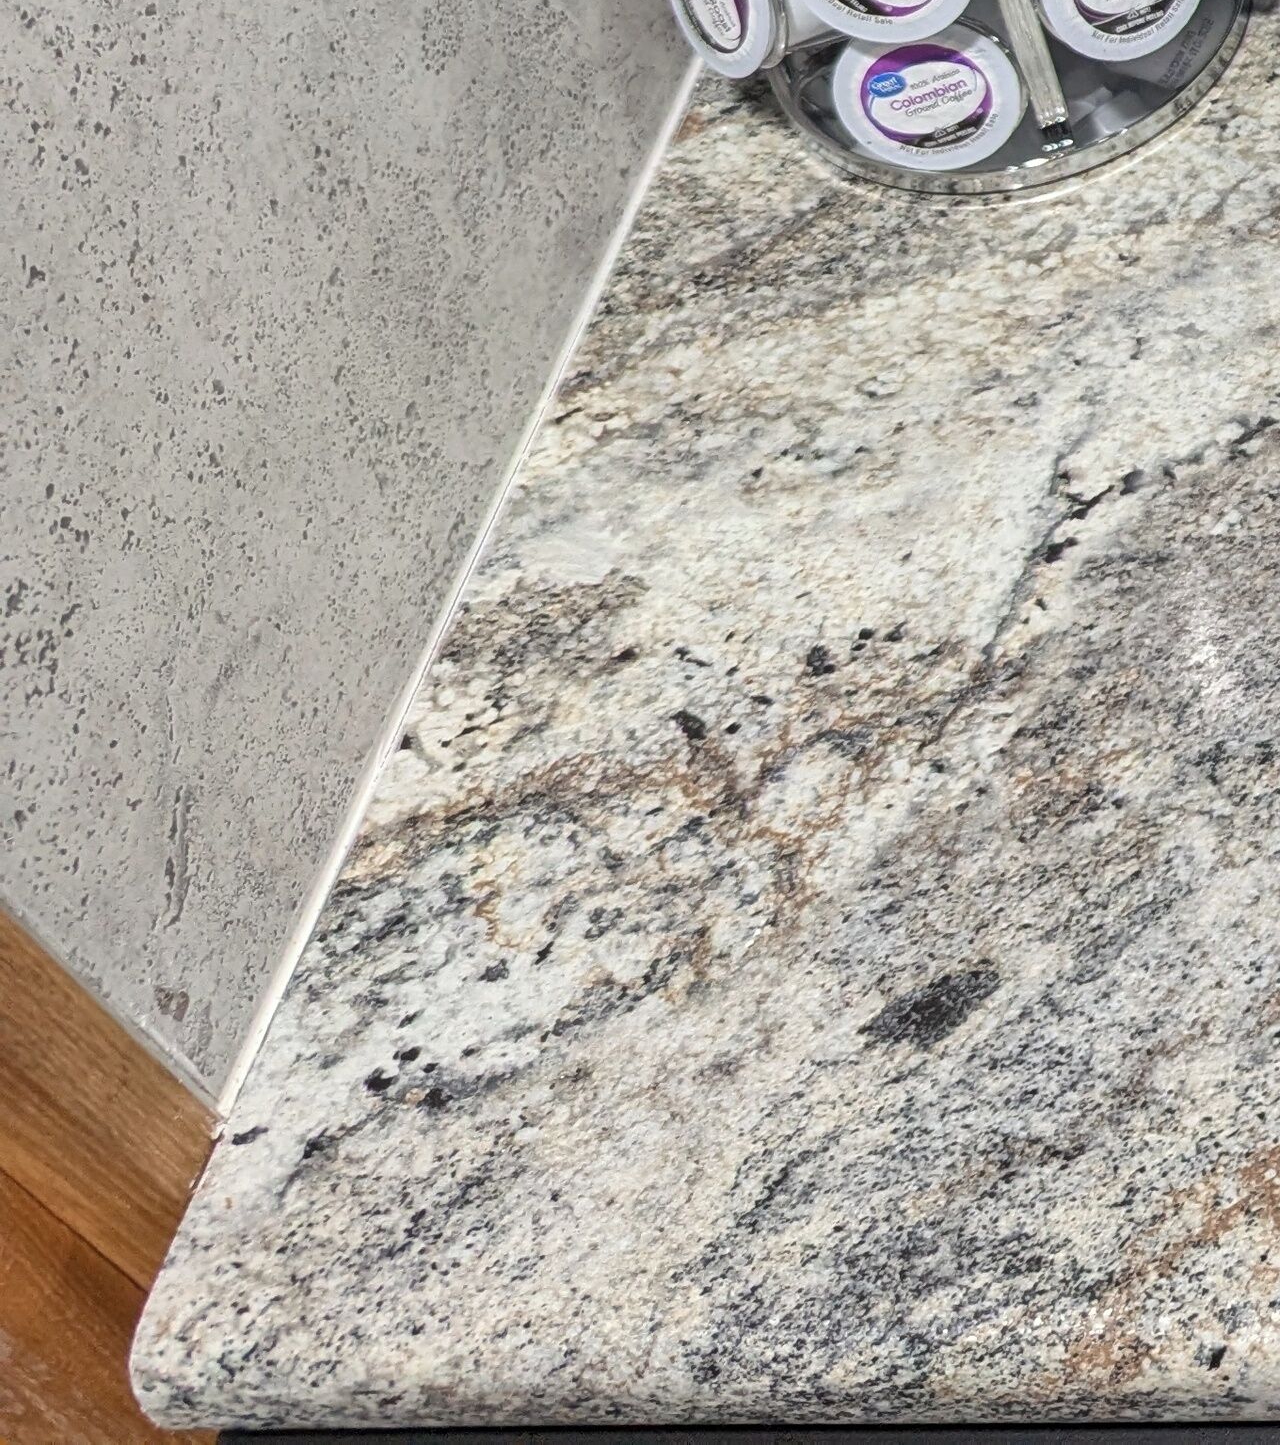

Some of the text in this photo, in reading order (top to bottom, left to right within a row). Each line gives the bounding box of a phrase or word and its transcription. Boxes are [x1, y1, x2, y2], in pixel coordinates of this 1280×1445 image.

[845, 8, 872, 23] Retail
[1156, 12, 1174, 32] Retail
[871, 77, 897, 89] Great
[890, 79, 968, 111] Colombian
[905, 88, 973, 118] Ground Coffee
[900, 144, 914, 153] Not
